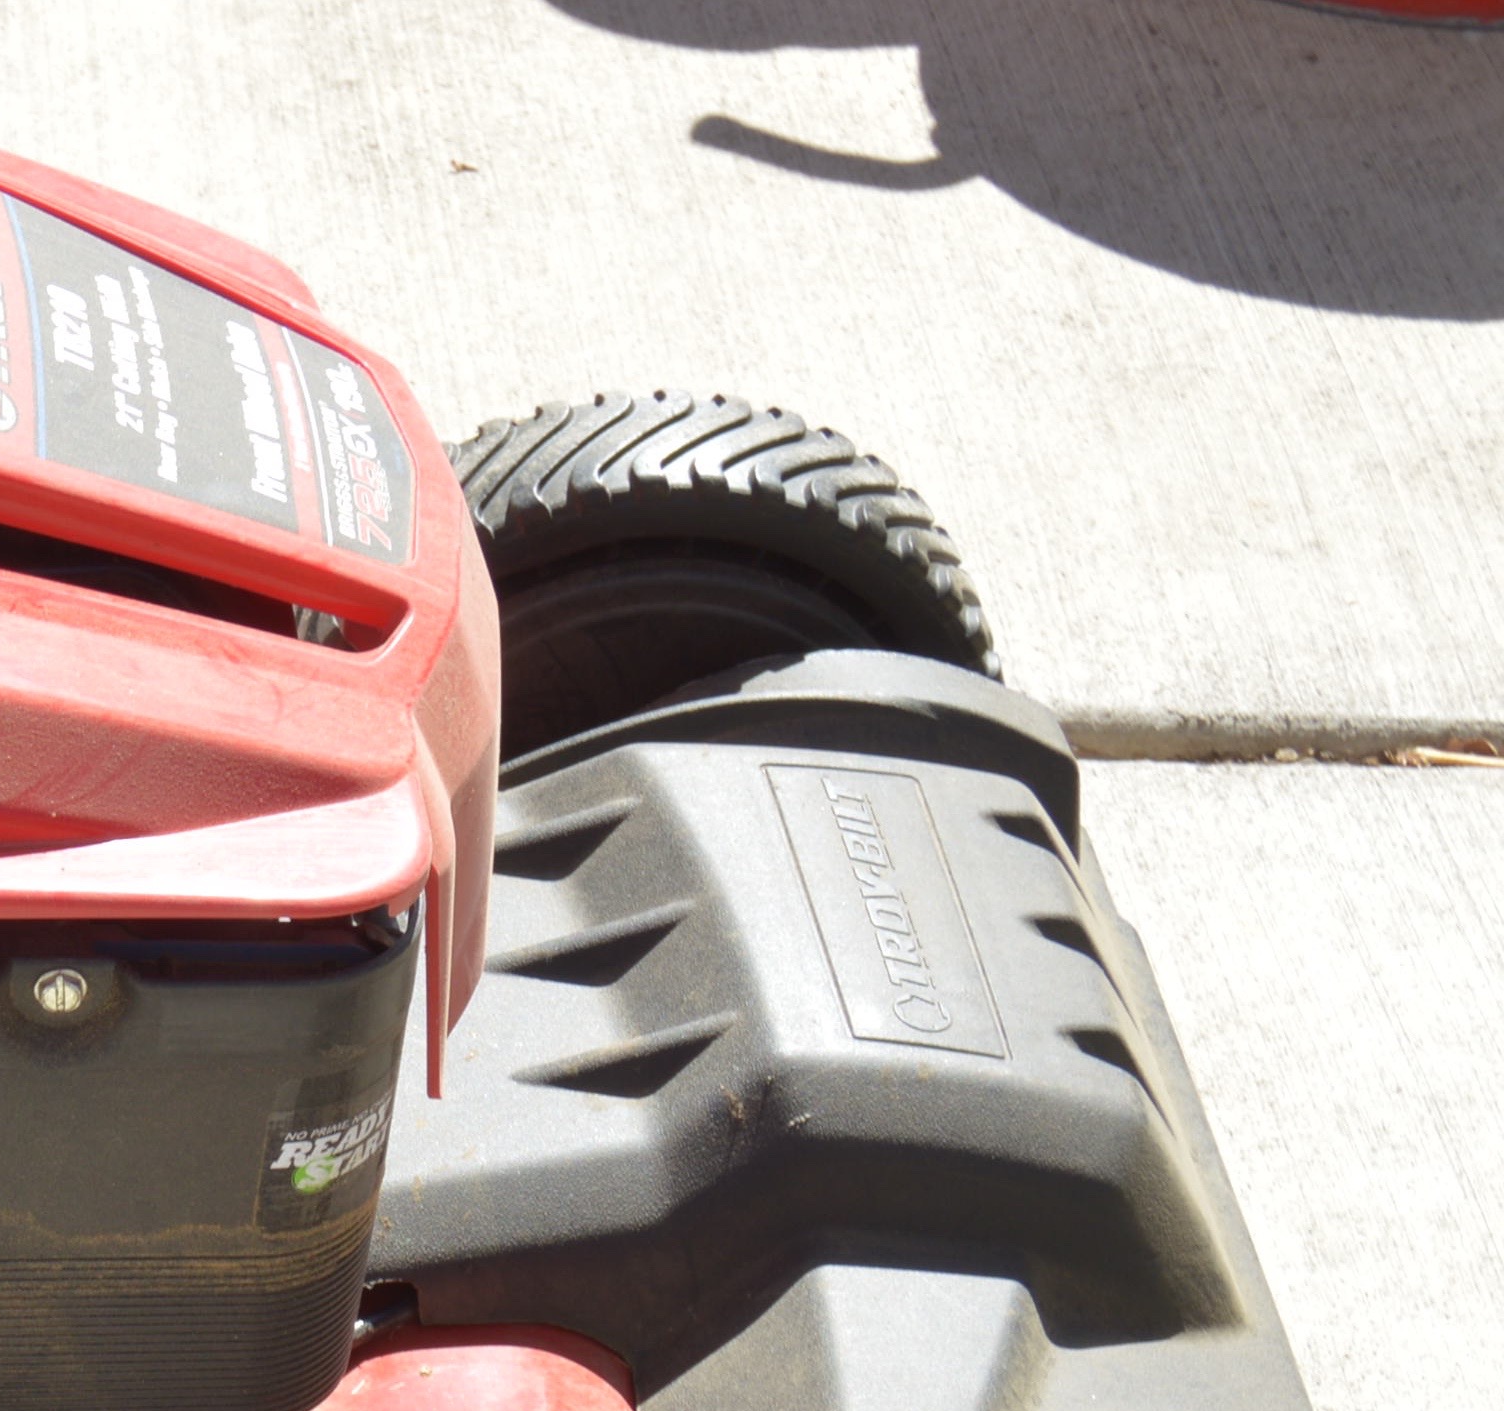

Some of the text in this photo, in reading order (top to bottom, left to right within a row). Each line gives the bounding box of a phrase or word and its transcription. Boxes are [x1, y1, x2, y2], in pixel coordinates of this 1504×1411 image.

[44, 280, 96, 375] TB210
[101, 318, 146, 399] Cutting
[270, 1096, 392, 1169] READY
[285, 1131, 307, 1141] NO
